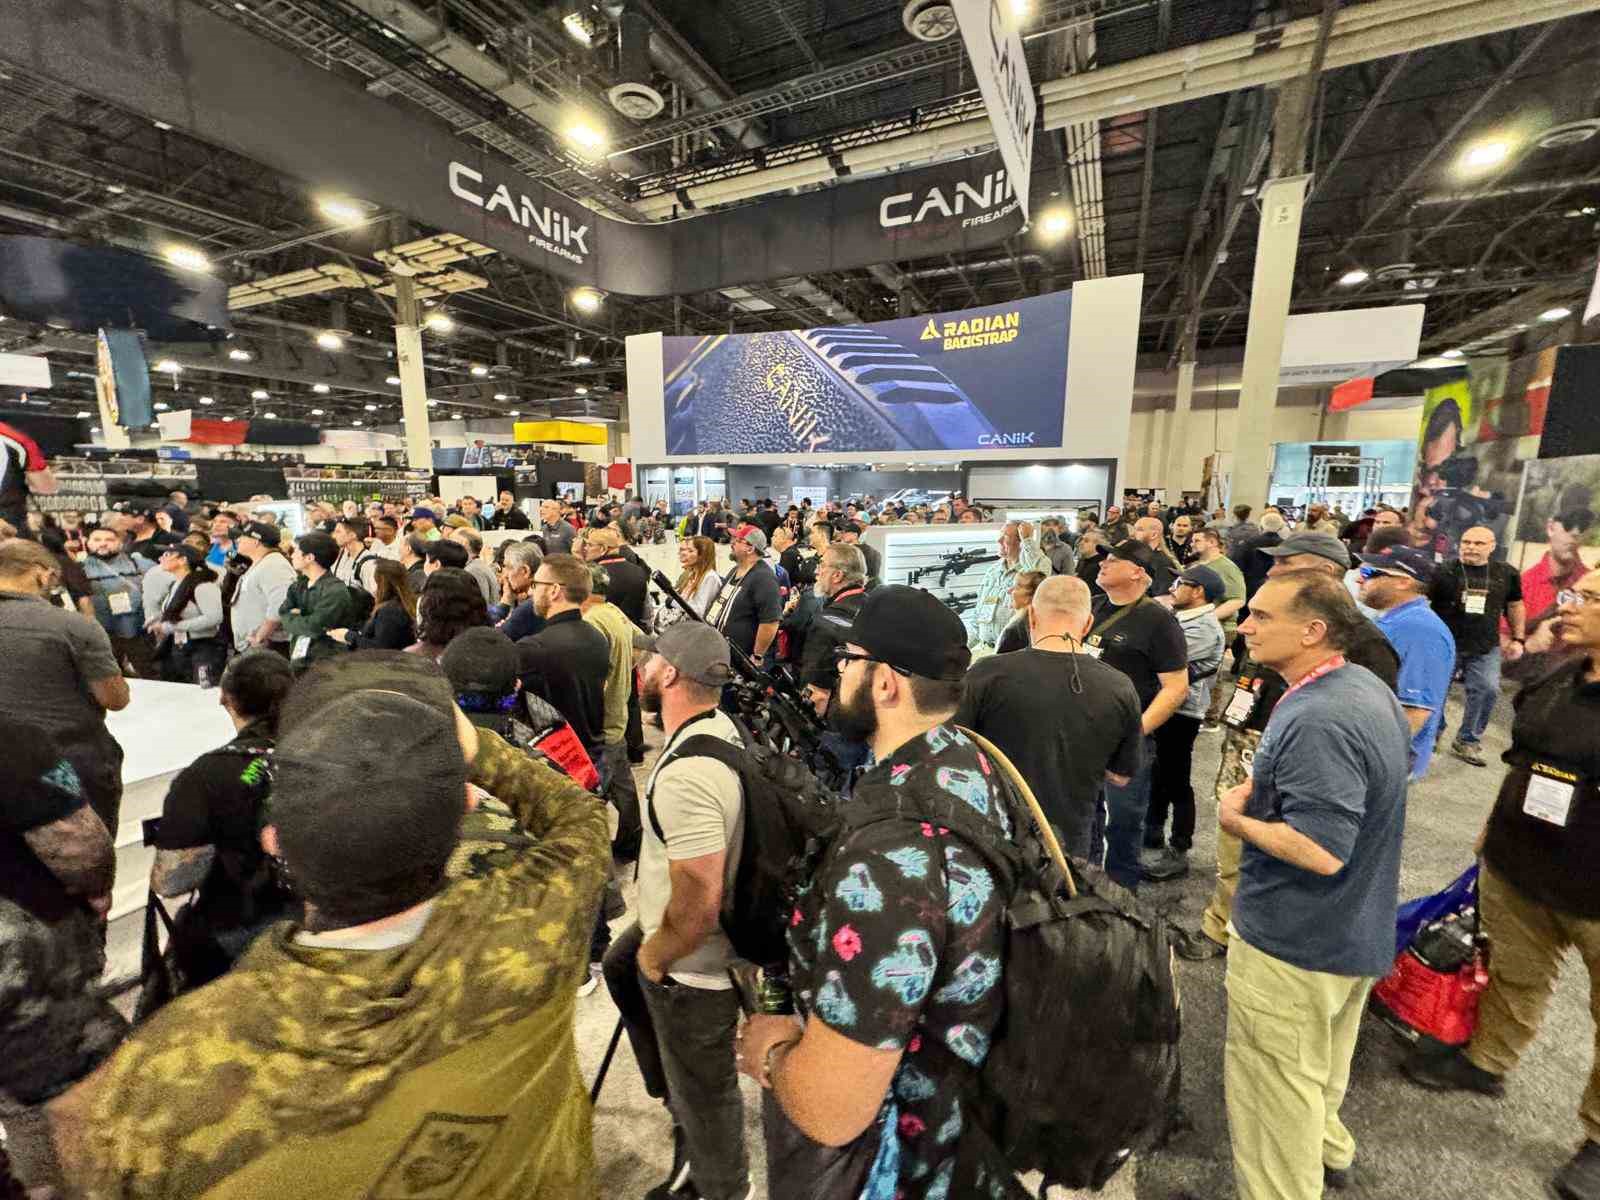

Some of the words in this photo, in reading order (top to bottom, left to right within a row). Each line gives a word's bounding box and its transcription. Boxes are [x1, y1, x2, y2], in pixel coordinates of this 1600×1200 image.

[528, 234, 584, 265] FIREARMS
[943, 311, 1020, 338] RADIAN
[943, 328, 1019, 351] BACKSTRAP
